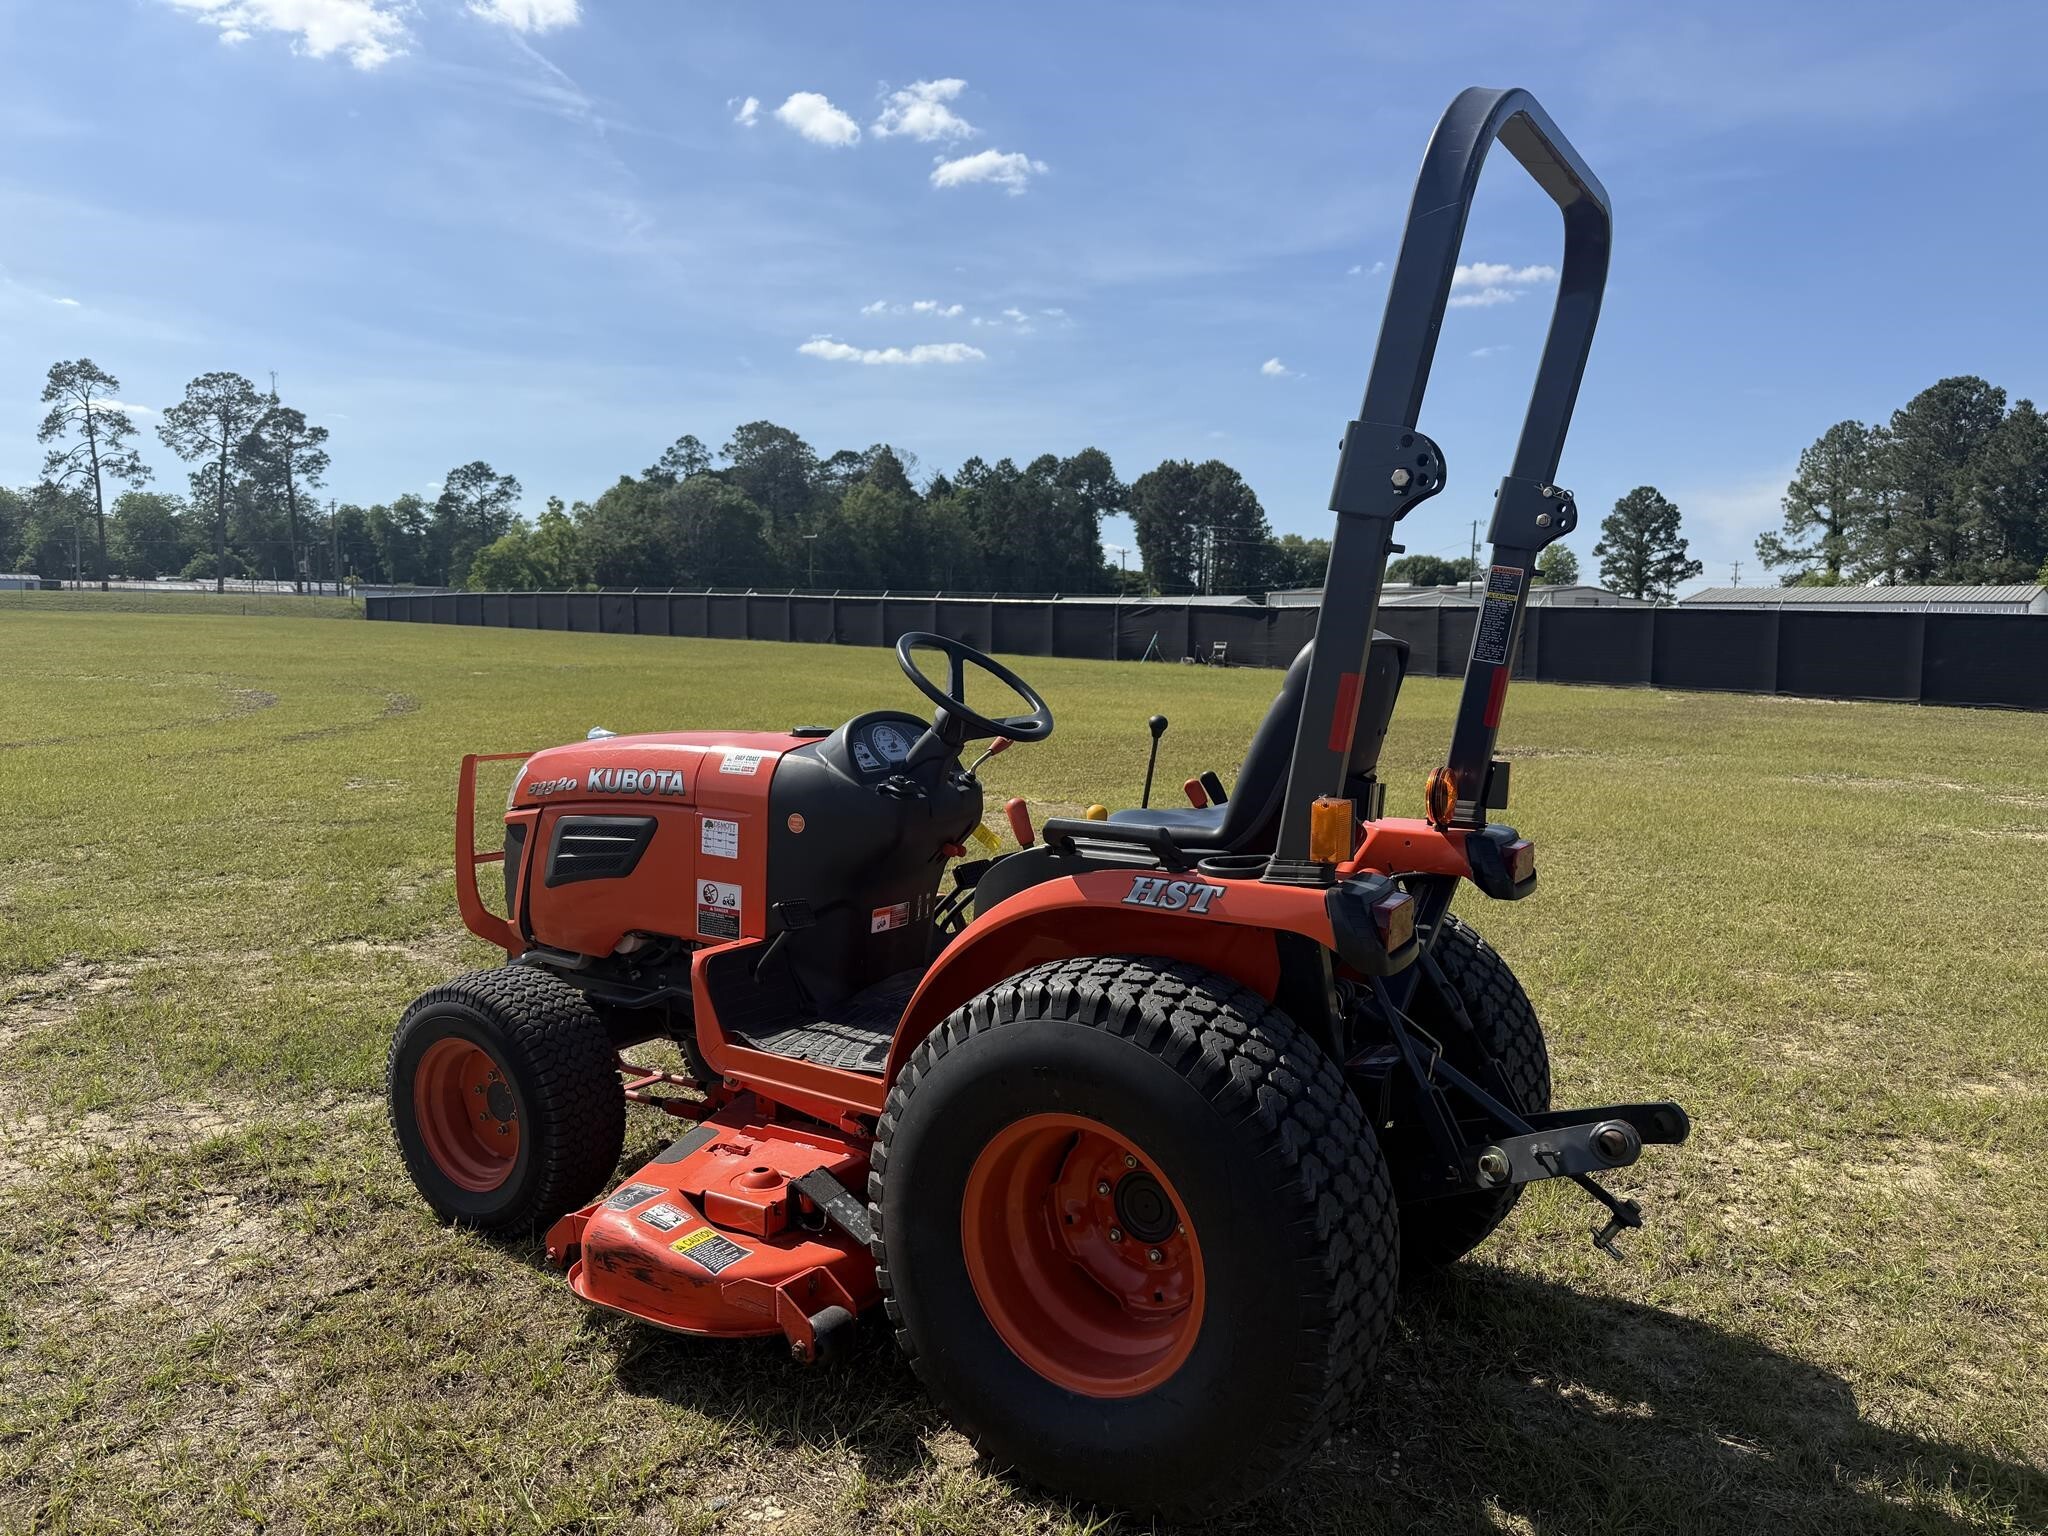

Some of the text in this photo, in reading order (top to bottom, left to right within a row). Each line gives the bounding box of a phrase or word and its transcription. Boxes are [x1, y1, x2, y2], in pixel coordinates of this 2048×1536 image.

[528, 777, 578, 796] B2320
[587, 767, 686, 796] KUBOTA
[1121, 876, 1226, 914] HST
[682, 1229, 715, 1247] CAUTION
